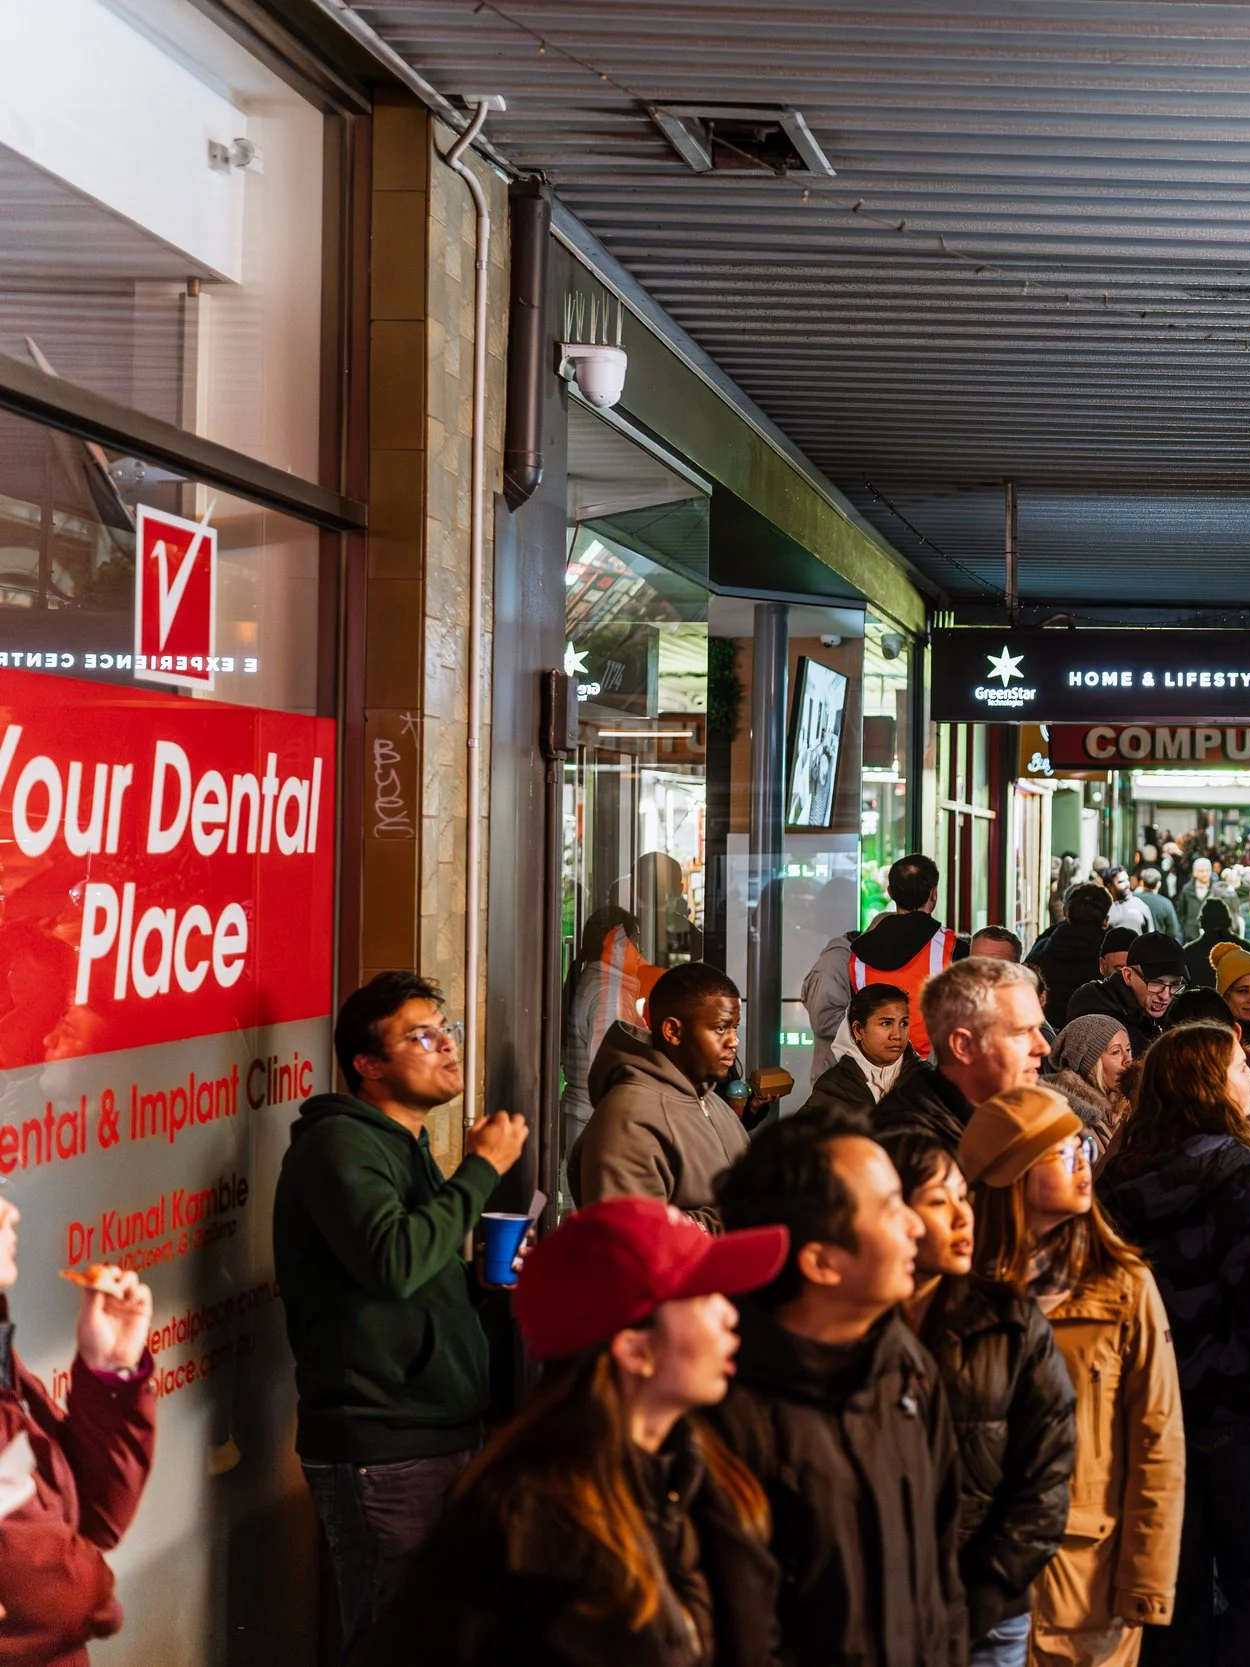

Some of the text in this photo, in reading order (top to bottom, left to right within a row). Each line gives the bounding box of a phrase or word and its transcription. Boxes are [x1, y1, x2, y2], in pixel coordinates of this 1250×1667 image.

[975, 686, 1036, 701] GreenStar
[987, 698, 1023, 707] Technologies
[1069, 671, 1132, 687] HOME
[1142, 672, 1155, 687] &
[146, 740, 323, 856] Dental
[783, 864, 828, 877] SLA
[75, 882, 249, 1009] Place
[0, 1051, 314, 1175] ental & Implant Clinic
[68, 1221, 95, 1266] Dr
[101, 1195, 166, 1255] Kunal
[171, 1172, 249, 1230] Kamble
